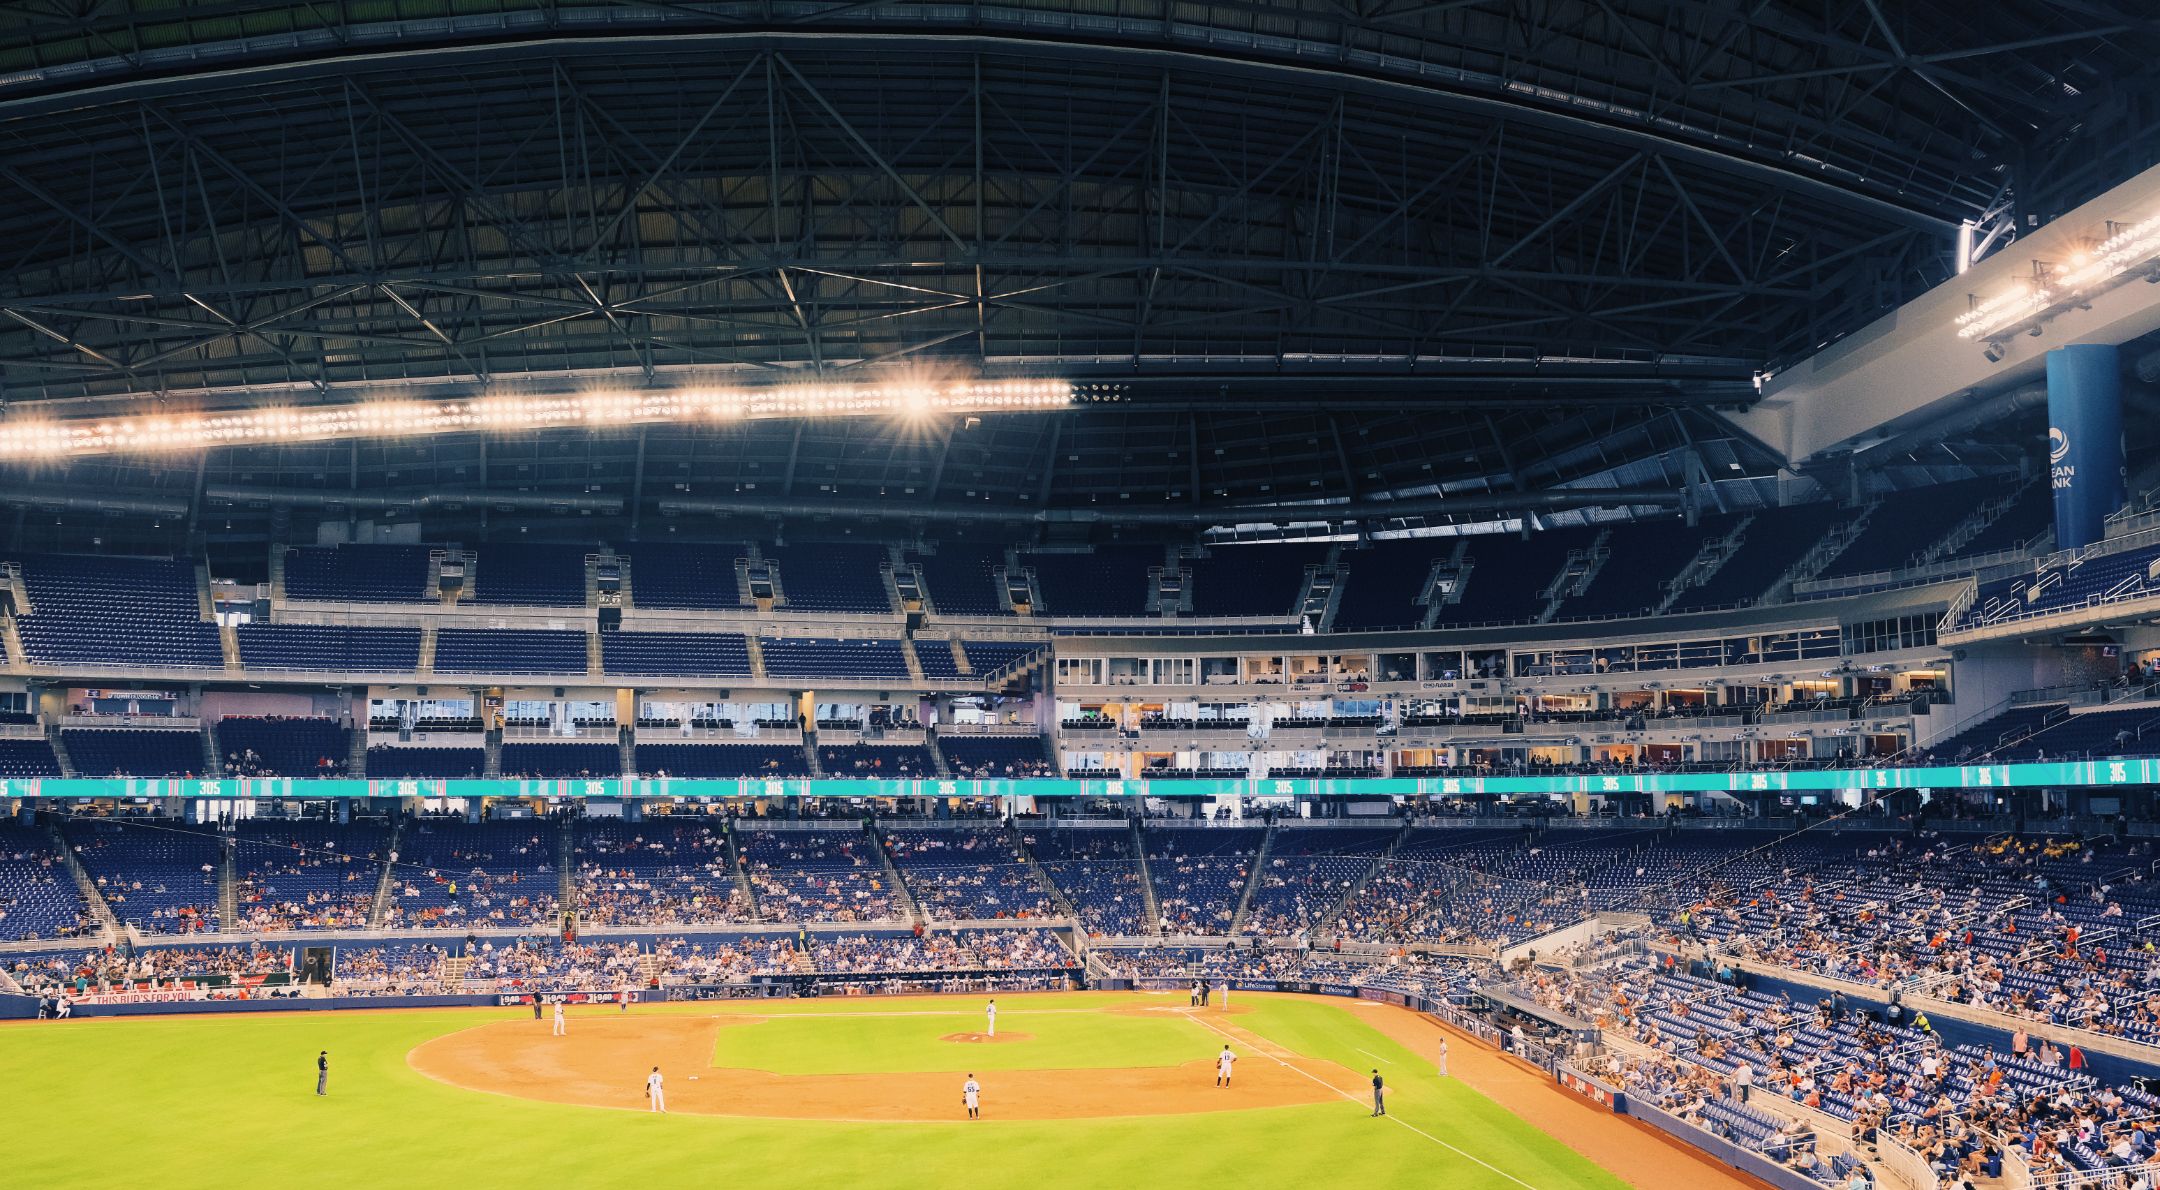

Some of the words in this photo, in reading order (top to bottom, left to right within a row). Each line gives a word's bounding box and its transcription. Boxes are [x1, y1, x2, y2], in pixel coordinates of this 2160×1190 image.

[2051, 466, 2075, 478] EAN
[2109, 763, 2127, 782] 305
[586, 781, 605, 794] 305
[766, 781, 784, 794] 305
[938, 781, 957, 794] 305
[1106, 781, 1124, 794] 305
[1275, 780, 1294, 793] 305
[1443, 779, 1460, 793] 305
[1603, 777, 1619, 790] 305
[1752, 774, 1767, 788] 305
[200, 782, 220, 795] 305
[398, 782, 417, 795] 305
[97, 996, 118, 1004] THIS
[120, 993, 149, 1003] BUD'S
[151, 992, 170, 1002] FOR
[172, 991, 192, 1001] YOU
